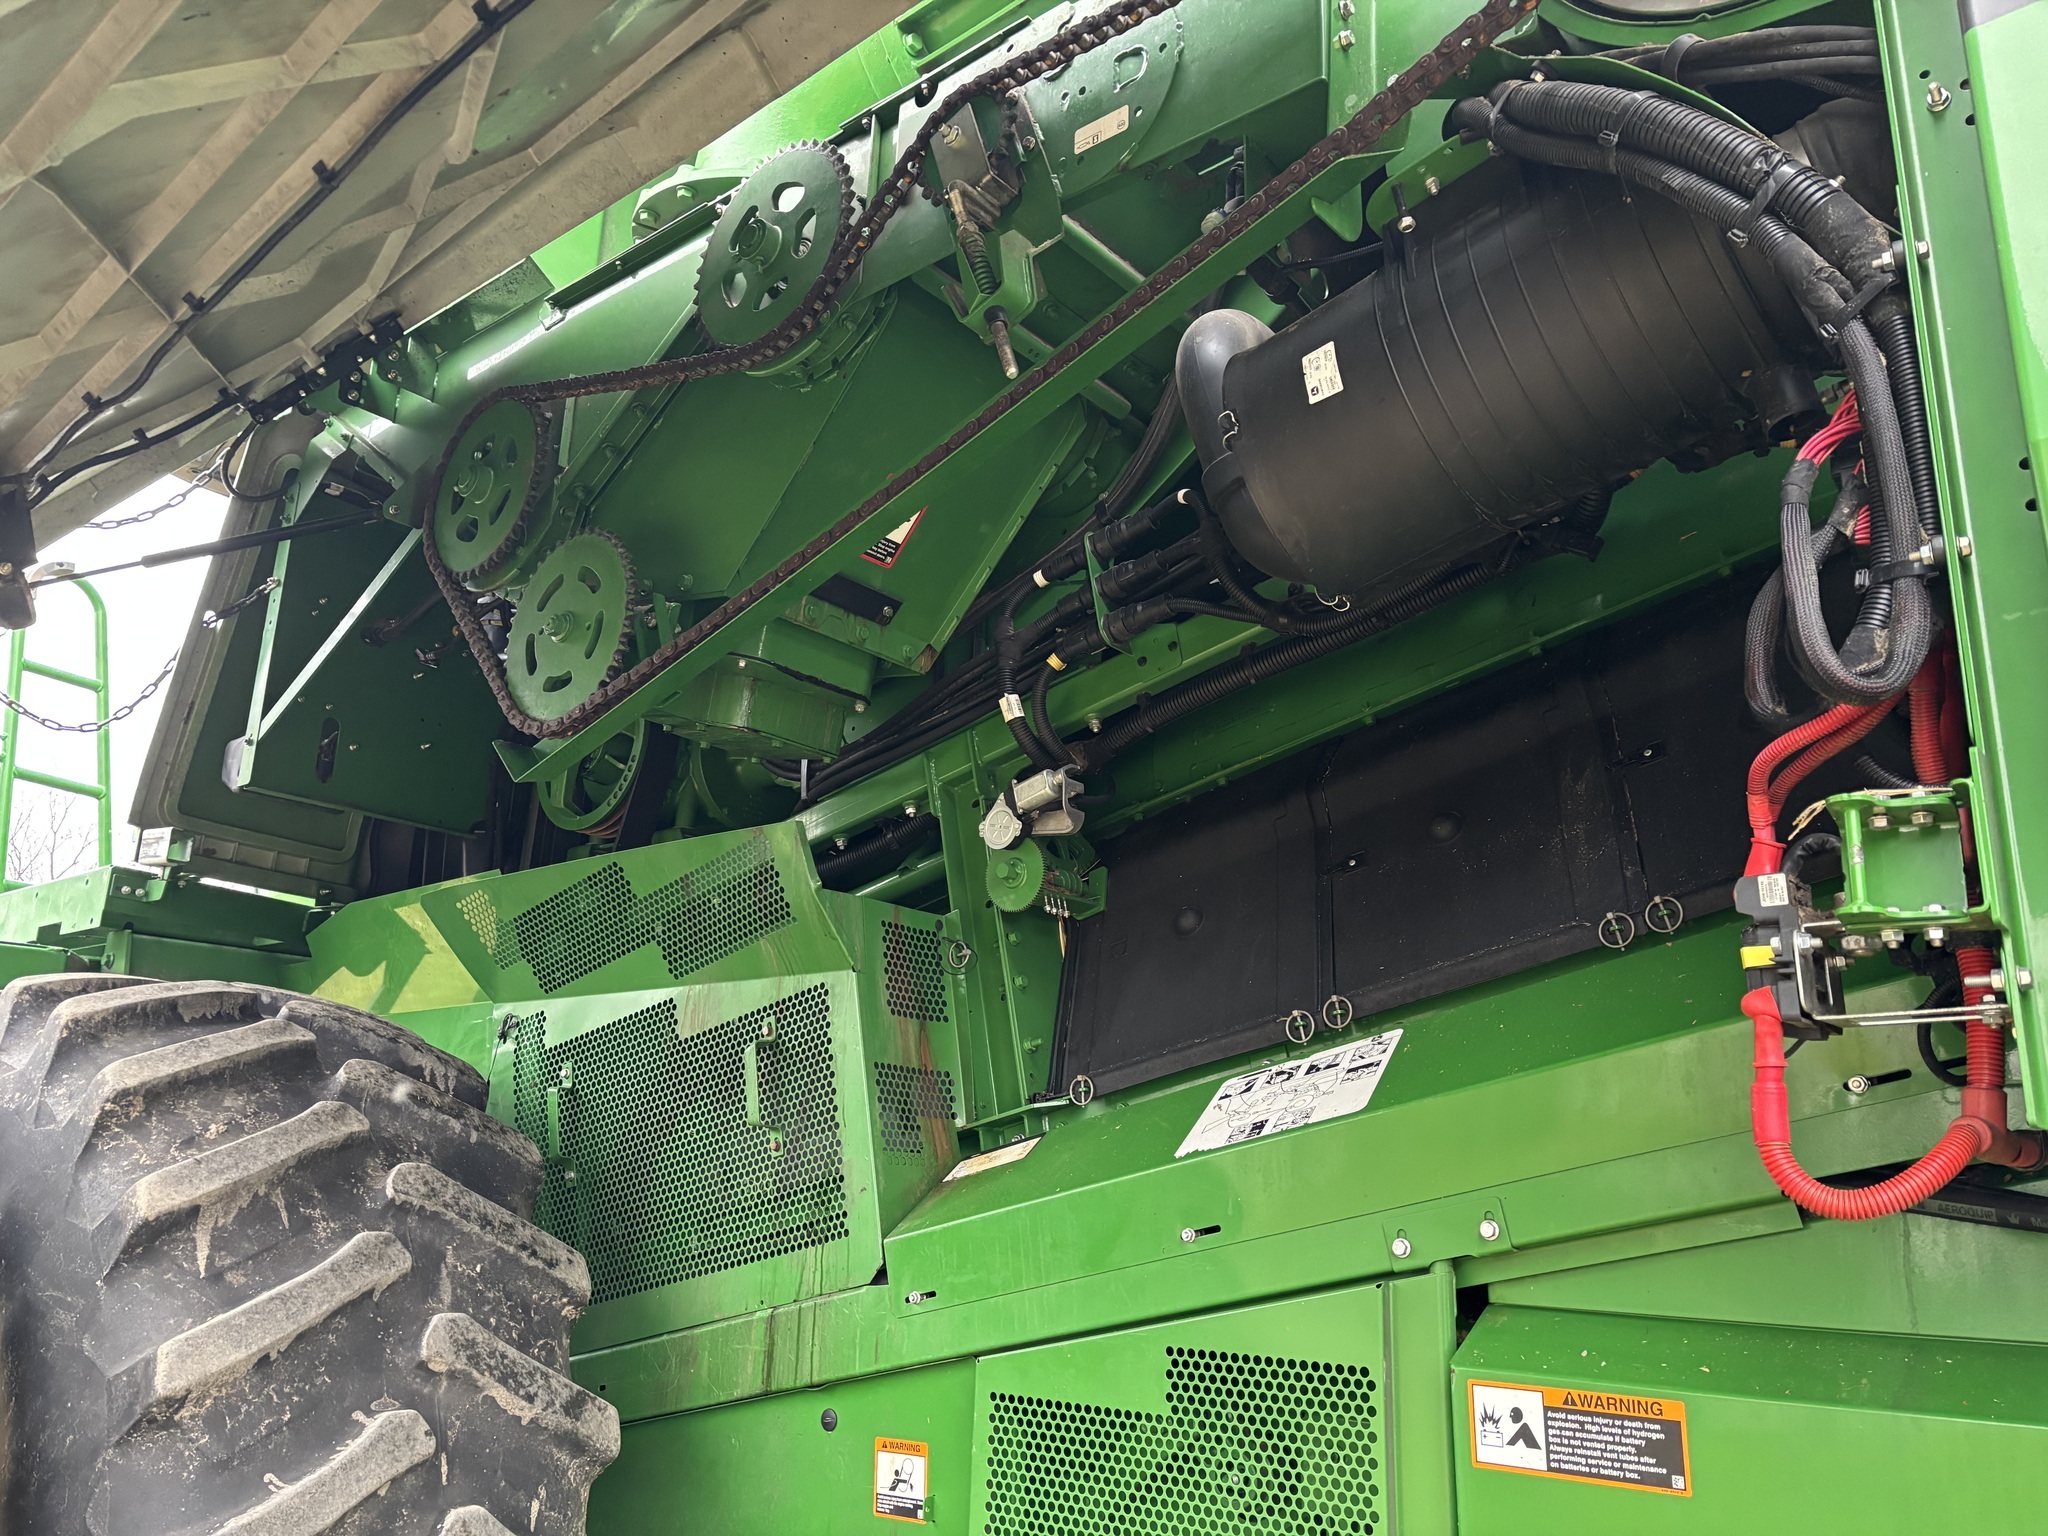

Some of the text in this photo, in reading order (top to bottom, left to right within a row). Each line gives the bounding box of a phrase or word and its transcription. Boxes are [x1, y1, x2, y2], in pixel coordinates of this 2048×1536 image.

[1937, 1203, 1994, 1219] AEROQUIP
[1578, 1394, 1663, 1416] WARNING
[1547, 1411, 1566, 1419] Avoid
[1567, 1414, 1592, 1422] serious
[1593, 1416, 1612, 1425] injury
[1624, 1420, 1643, 1428] death
[1644, 1422, 1661, 1430] from
[1547, 1420, 1665, 1440] explosion. High levels of hydrogen
[889, 1441, 921, 1452] WARNING
[1575, 1431, 1613, 1442] accumulate
[1621, 1436, 1646, 1447] battery
[1583, 1440, 1605, 1449] vented
[1607, 1444, 1637, 1454] properly.
[1549, 1445, 1656, 1464] Always reinstall vent tubes after
[1550, 1453, 1586, 1464] performing
[1588, 1458, 1612, 1467] service
[1623, 1462, 1667, 1474] maintenance
[1561, 1462, 1589, 1473] batteries
[1600, 1468, 1624, 1478] battery
